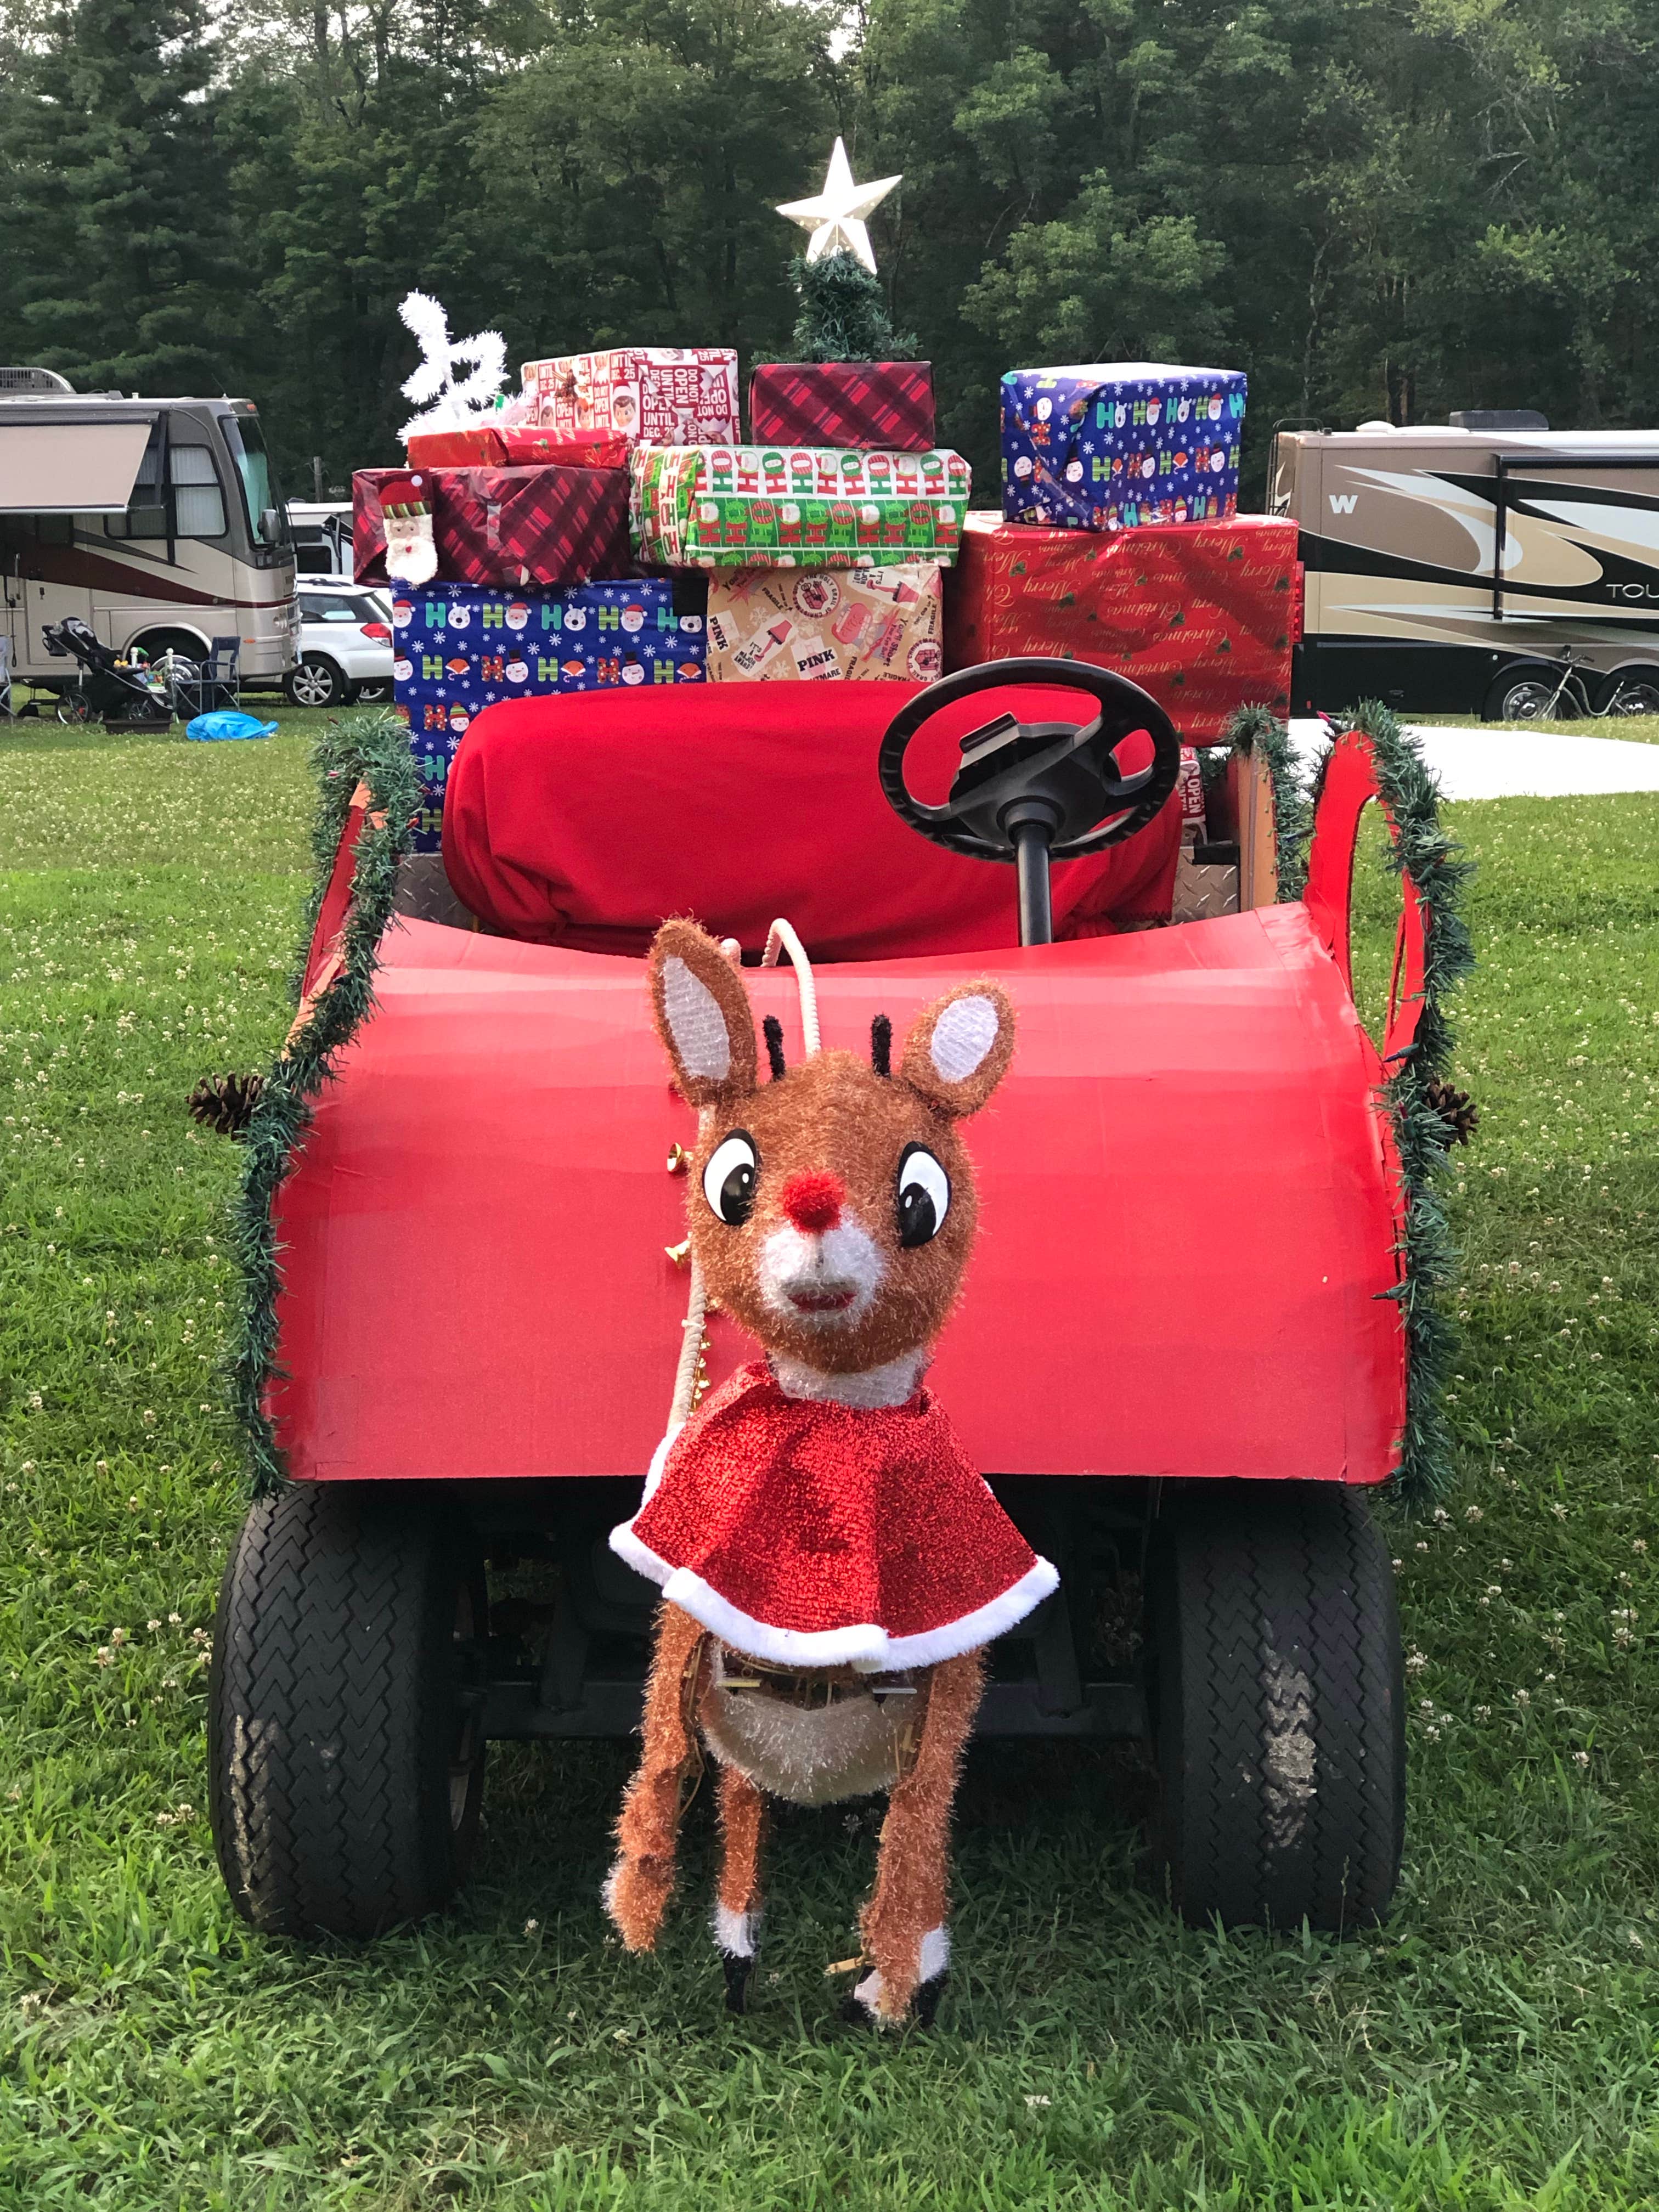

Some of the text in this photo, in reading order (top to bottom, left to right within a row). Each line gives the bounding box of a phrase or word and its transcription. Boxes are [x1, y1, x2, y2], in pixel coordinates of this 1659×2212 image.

[624, 368, 635, 379] 25
[674, 368, 689, 404] OPEN
[688, 369, 699, 403] DO NOT
[644, 411, 675, 426] UNTIL
[697, 404, 729, 417] DO NOT
[644, 427, 663, 438] DEC.
[1329, 494, 1358, 514] W
[1107, 531, 1247, 563] Merry Christmas
[820, 574, 835, 587] HOLY
[860, 568, 870, 585] AJOR
[1239, 558, 1289, 587] Merry
[762, 586, 785, 611] FRAGILE
[830, 588, 838, 606] GRAIL
[1023, 576, 1080, 600] Merry
[792, 594, 823, 618] CHRISTMAS
[1107, 600, 1181, 620] Christmas
[928, 603, 937, 635] FRAGILE
[709, 616, 729, 651] PINK
[1153, 627, 1228, 648] Christmas
[749, 641, 763, 653] IT'S
[1023, 635, 1070, 658] Merry
[740, 651, 757, 666] MAJOR
[797, 648, 836, 672] PINK
[844, 656, 858, 680] FRAGIL
[1187, 777, 1202, 814] OPEN
